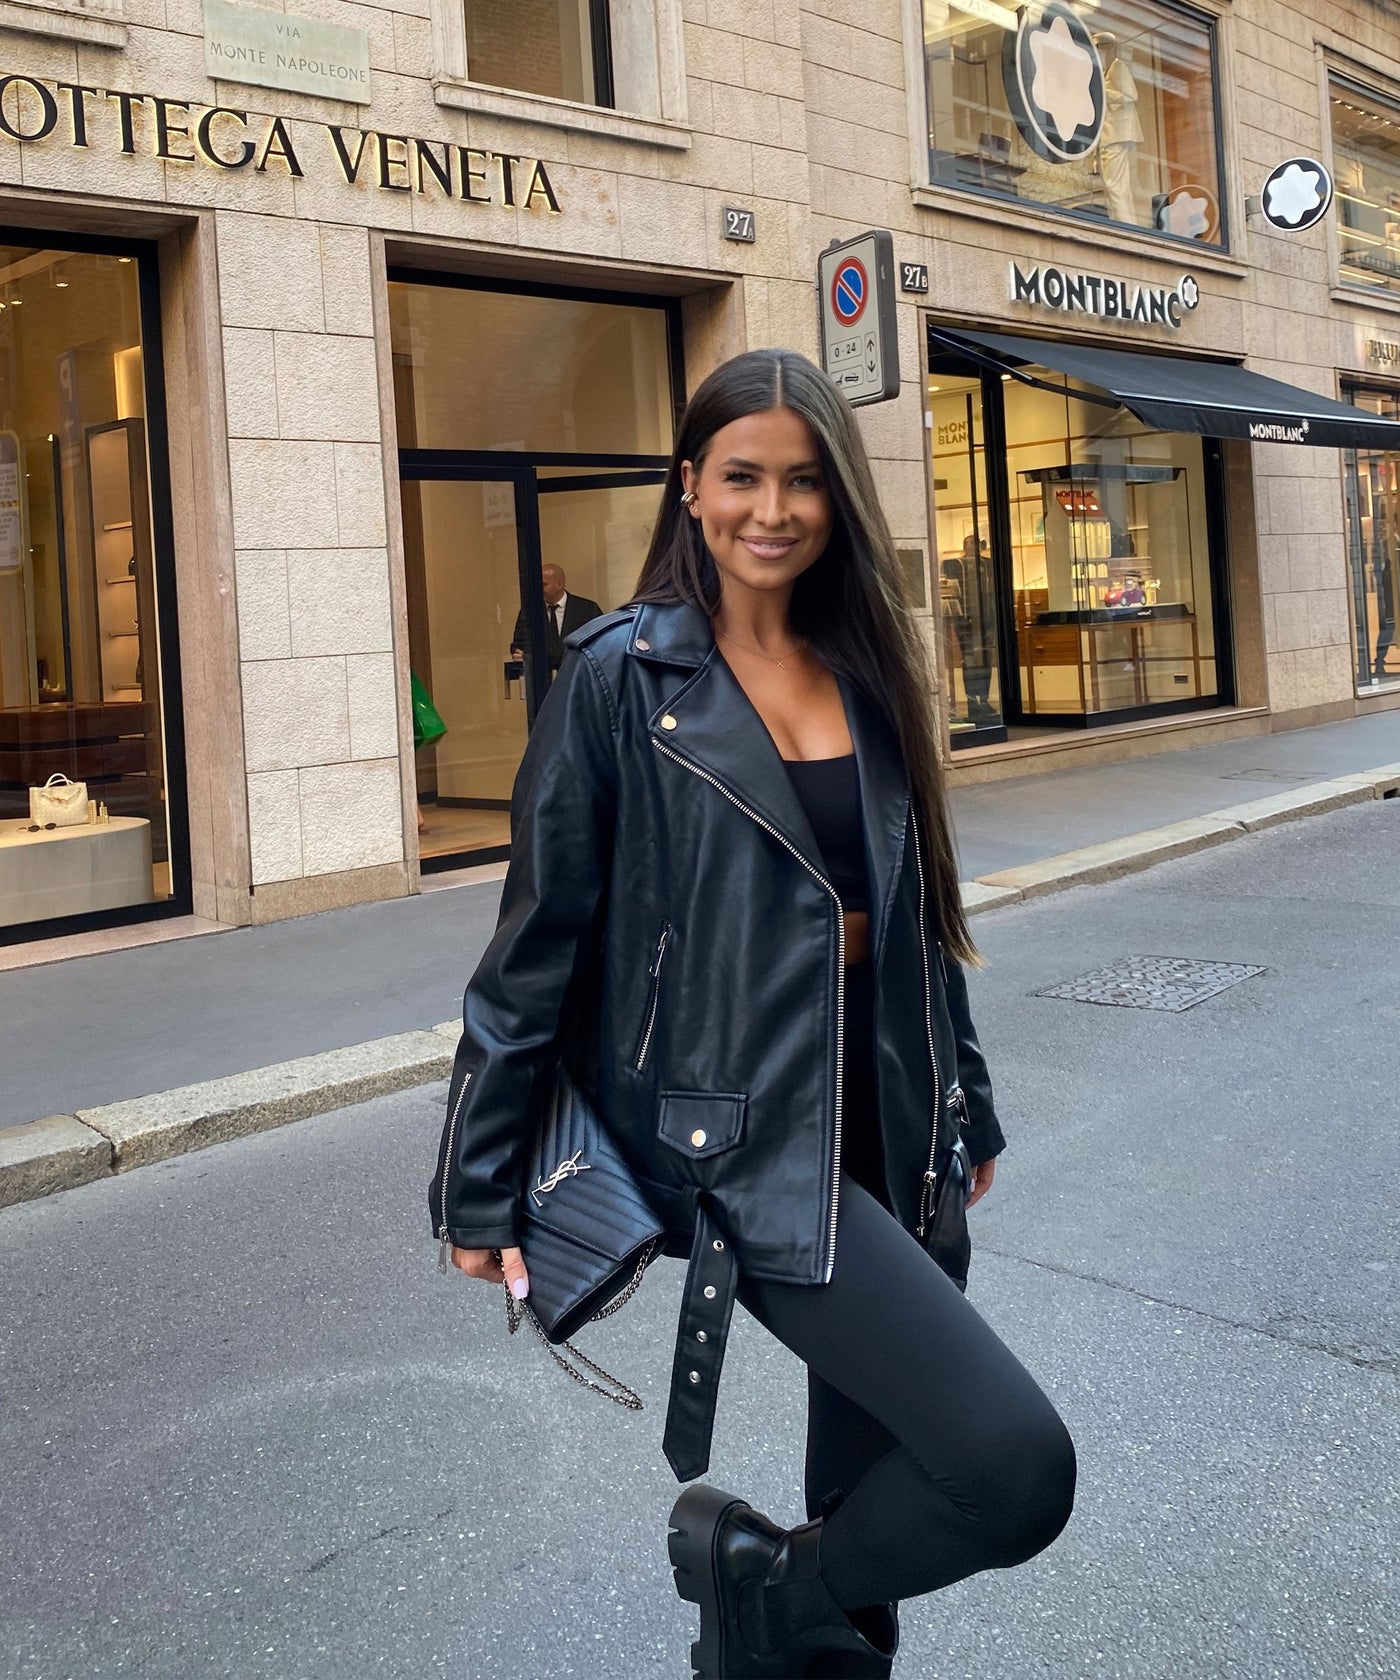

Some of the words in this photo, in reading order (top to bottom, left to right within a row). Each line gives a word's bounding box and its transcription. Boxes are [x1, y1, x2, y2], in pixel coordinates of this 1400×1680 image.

[276, 24, 301, 39] VIA
[210, 42, 266, 65] MONTE
[276, 54, 367, 83] NAPOLEONE
[0, 74, 305, 178] OTTEGA
[327, 125, 562, 213] VENETA
[1009, 259, 1182, 329] MONTBLANC
[938, 420, 969, 435] MON
[1249, 422, 1305, 443] MONTBLANC
[938, 431, 969, 446] BLAN
